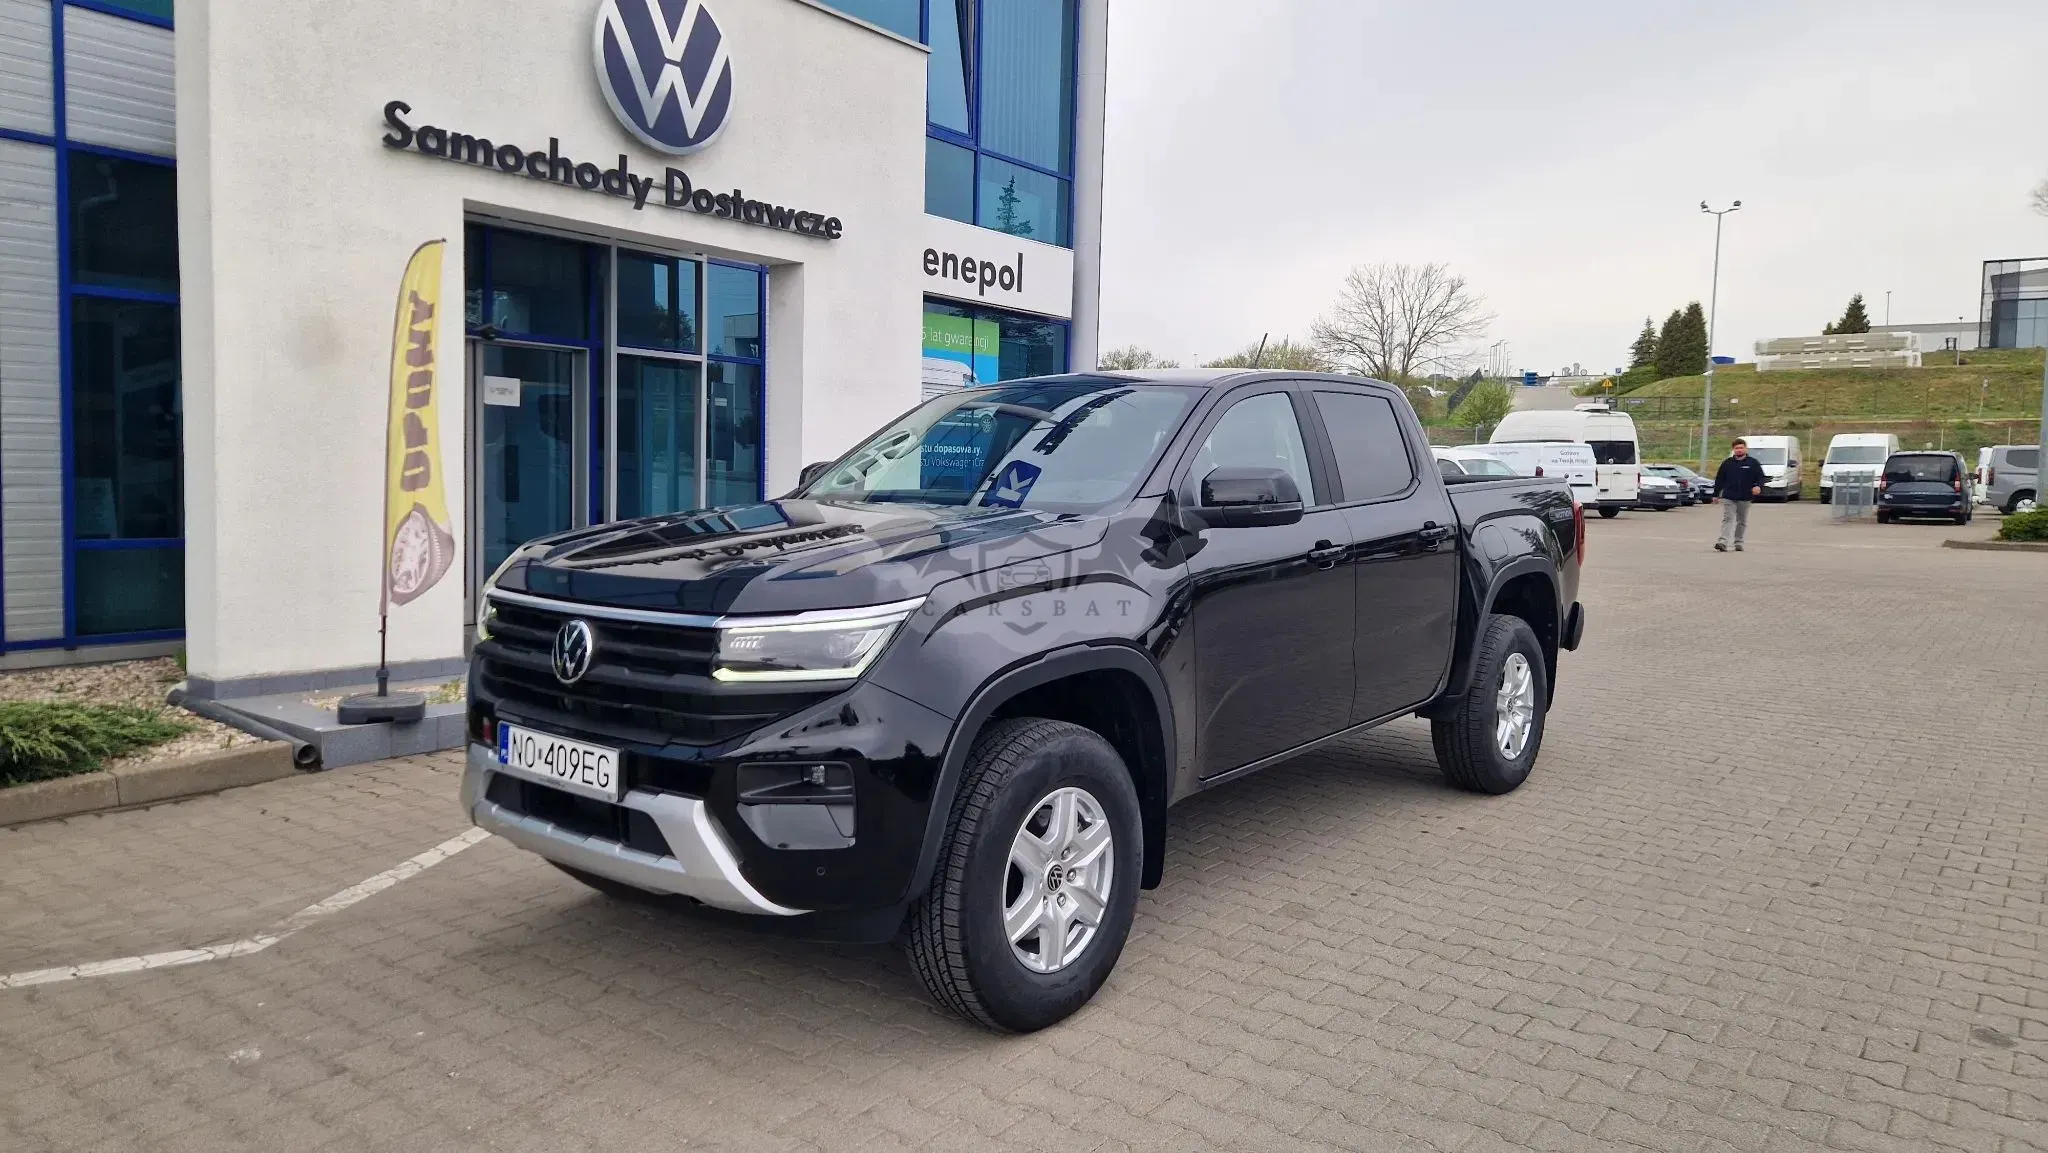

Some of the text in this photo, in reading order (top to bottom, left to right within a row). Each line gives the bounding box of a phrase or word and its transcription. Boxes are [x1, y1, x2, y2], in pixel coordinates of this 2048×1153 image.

[383, 101, 843, 240] Samochody Dostawcze
[923, 248, 1024, 296] enepol
[930, 327, 942, 342] lat
[400, 290, 435, 492] OPONY
[512, 733, 610, 788] NO 409EG
